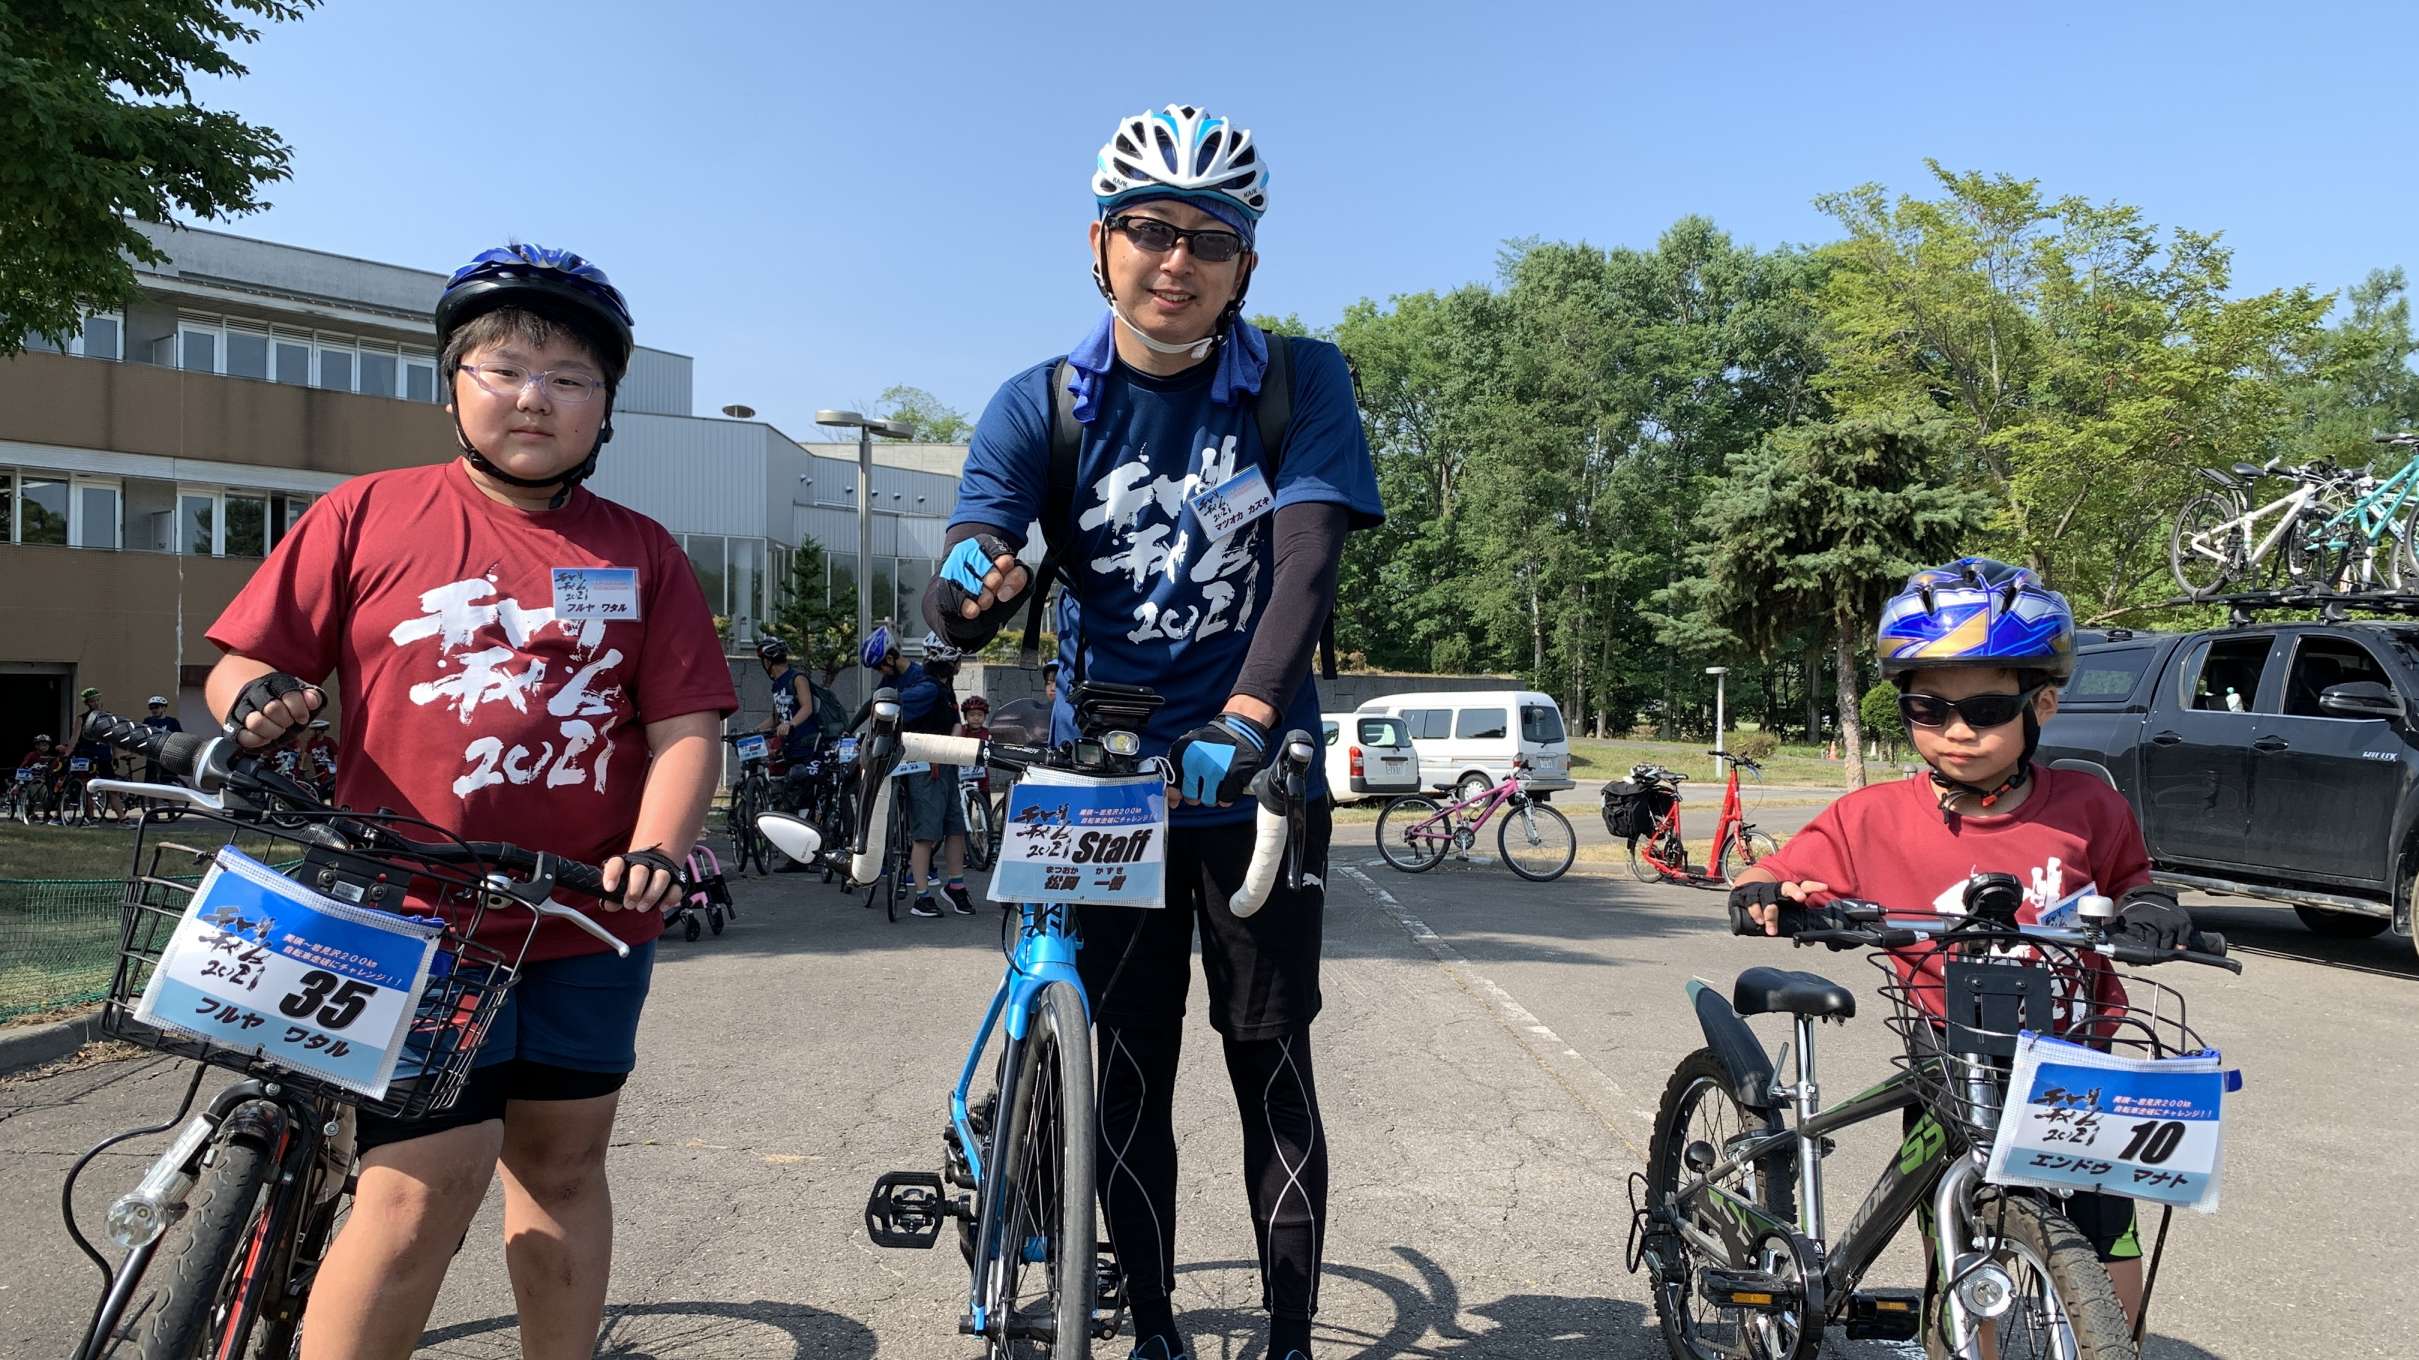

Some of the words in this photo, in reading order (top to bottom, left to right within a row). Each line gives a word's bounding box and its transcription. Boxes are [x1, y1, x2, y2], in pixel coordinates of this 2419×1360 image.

[1215, 512, 1244, 531] マツオカ
[568, 603, 595, 612] フルヤ
[601, 603, 627, 612] ワタル
[452, 716, 616, 799] 2021
[2362, 751, 2398, 762] HILUX
[1026, 838, 1072, 858] 2021
[1071, 828, 1153, 864] Staff
[201, 959, 267, 992] 2021
[279, 969, 378, 1029] 35
[195, 996, 265, 1030] フルヤ
[283, 1026, 351, 1057] ワタル
[2042, 1126, 2100, 1146] 2021
[2117, 1121, 2187, 1165] 10
[2029, 1153, 2113, 1176] エンドウ
[2133, 1168, 2189, 1189] マナト
